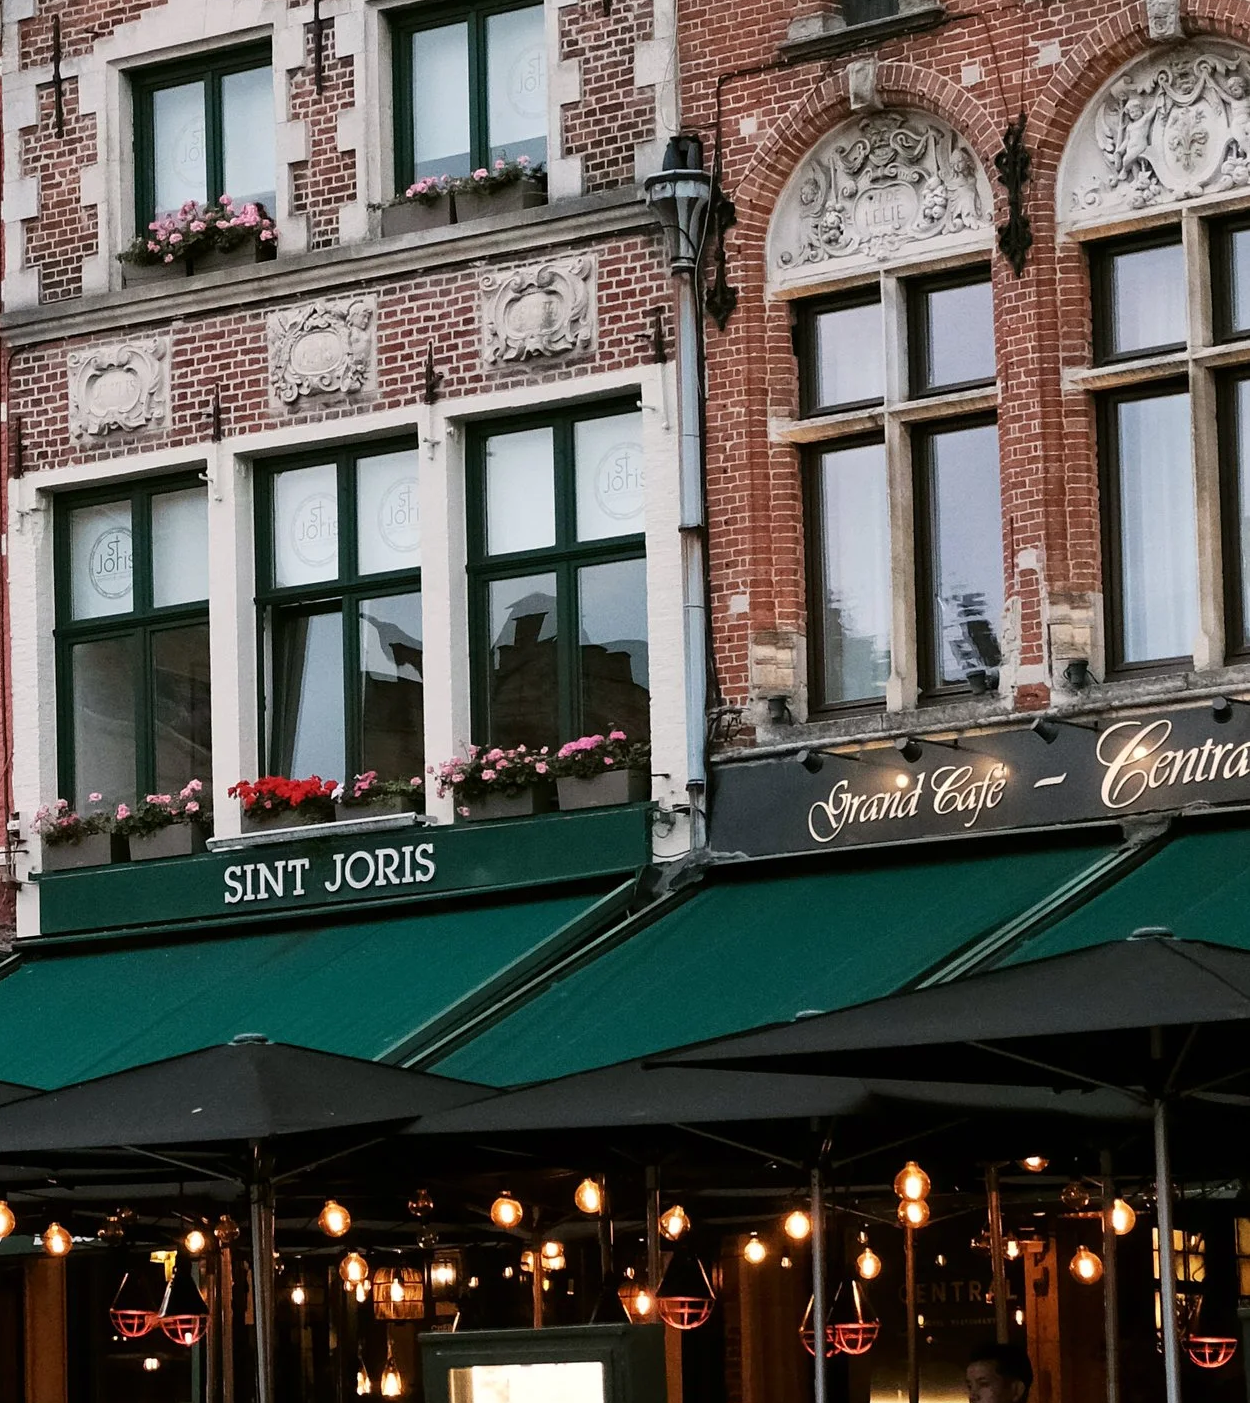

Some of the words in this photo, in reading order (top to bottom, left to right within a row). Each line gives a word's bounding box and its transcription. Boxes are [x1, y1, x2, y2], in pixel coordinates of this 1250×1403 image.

[807, 771, 927, 843] Grand
[929, 764, 1008, 828] Café
[1095, 719, 1250, 810] Centra
[223, 857, 310, 904] SINT
[324, 843, 436, 893] JORIS
